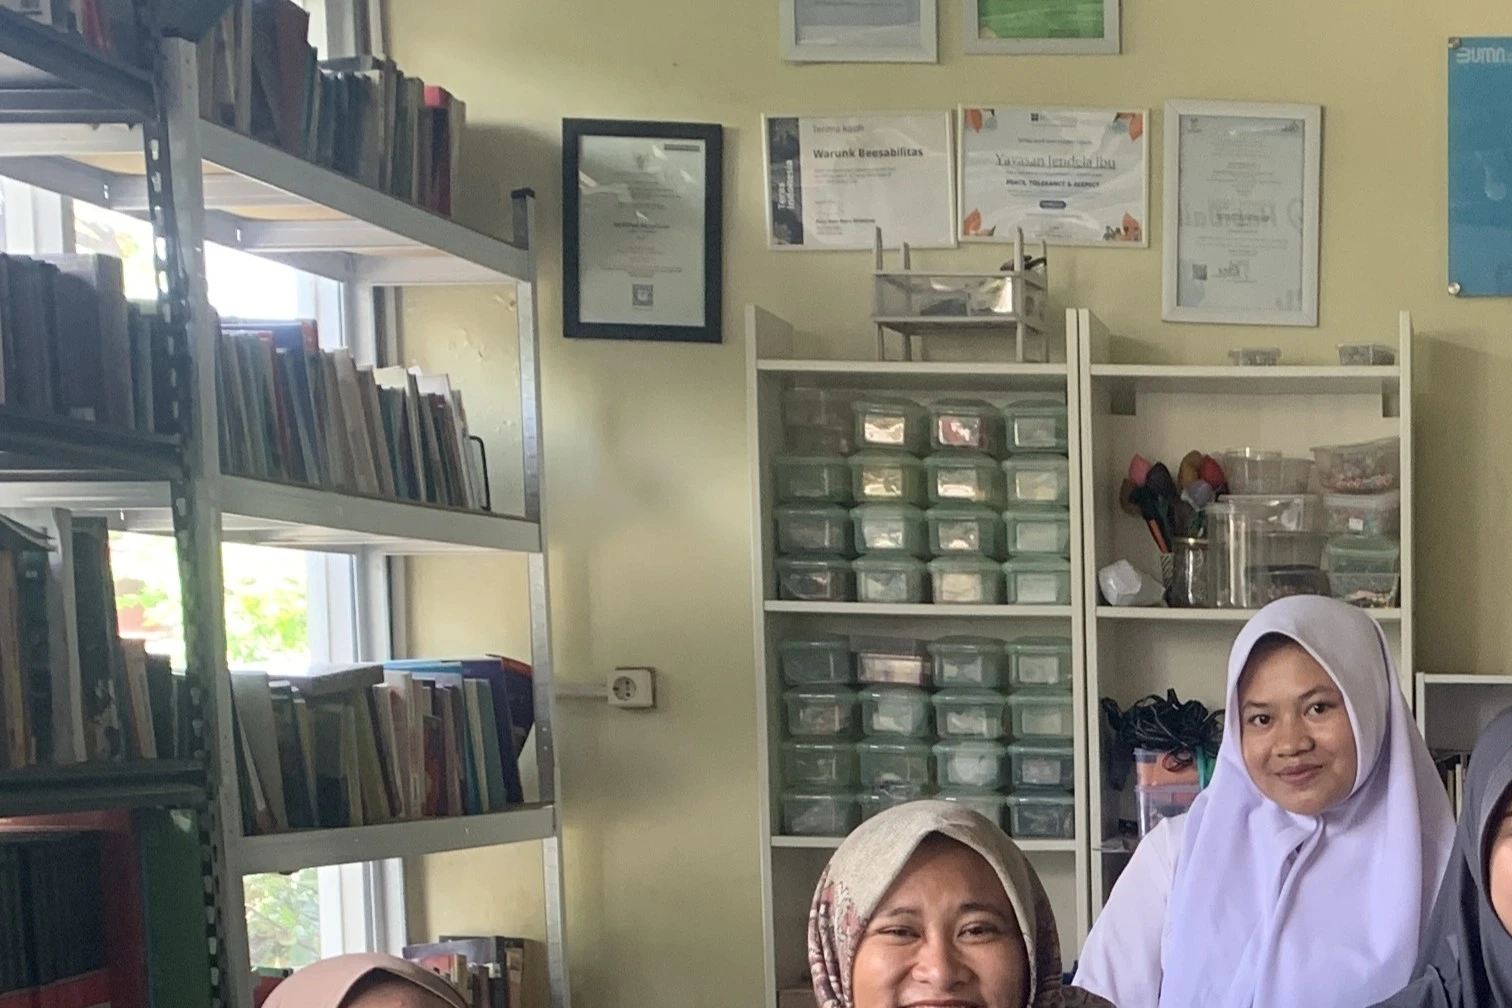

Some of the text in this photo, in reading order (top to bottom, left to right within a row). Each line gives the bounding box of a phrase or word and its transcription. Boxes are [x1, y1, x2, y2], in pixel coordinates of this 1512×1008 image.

[813, 147, 924, 159] Warunk Beesabilitas
[995, 153, 1045, 168] Yayasan
[1047, 154, 1092, 169] Jendela
